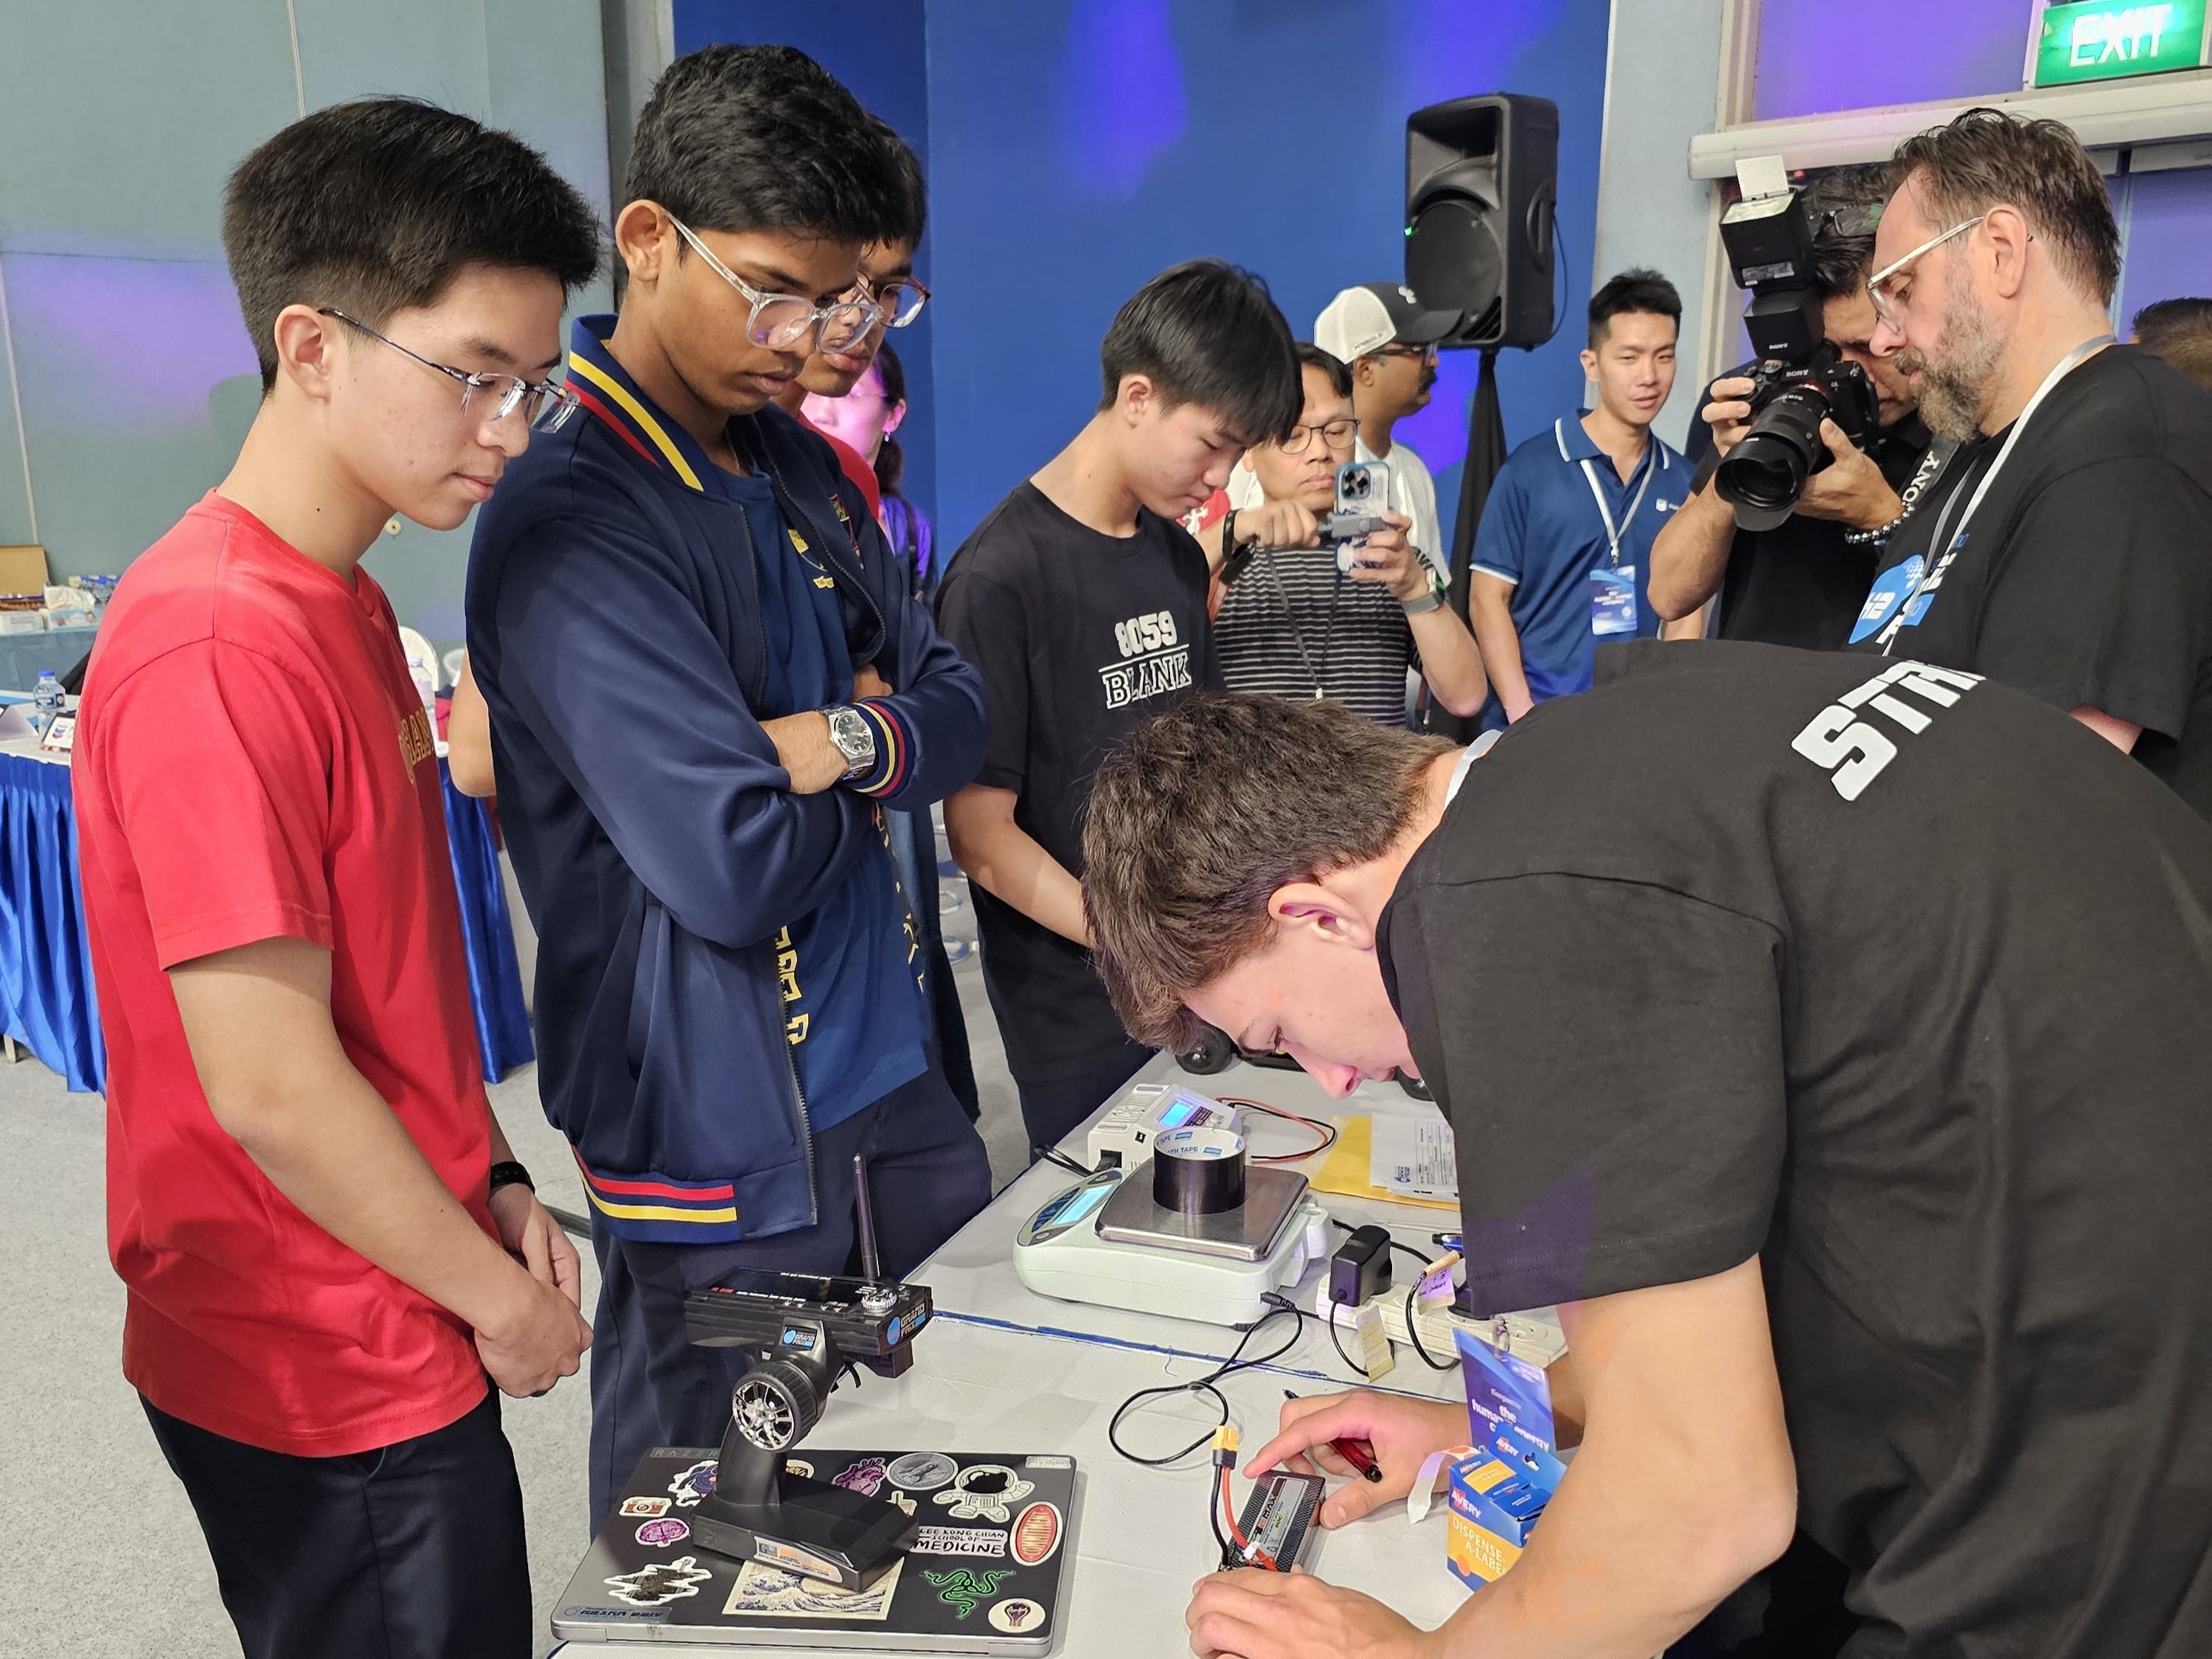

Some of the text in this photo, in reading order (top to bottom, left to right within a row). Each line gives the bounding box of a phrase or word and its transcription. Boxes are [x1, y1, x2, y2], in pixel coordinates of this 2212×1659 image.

[2070, 4, 2172, 67] EXIT
[1786, 369, 1809, 378] SONY
[1902, 450, 1940, 503] ONY
[1114, 610, 1178, 658] 8059
[1102, 651, 1192, 709] BLANK
[1790, 659, 1987, 802] STR
[1499, 1405, 1517, 1424] the
[654, 1449, 719, 1458] RAZER
[1496, 1438, 1519, 1457] AVERY
[1451, 1489, 1482, 1518] AVERY
[913, 1540, 1003, 1555] MEDICINE
